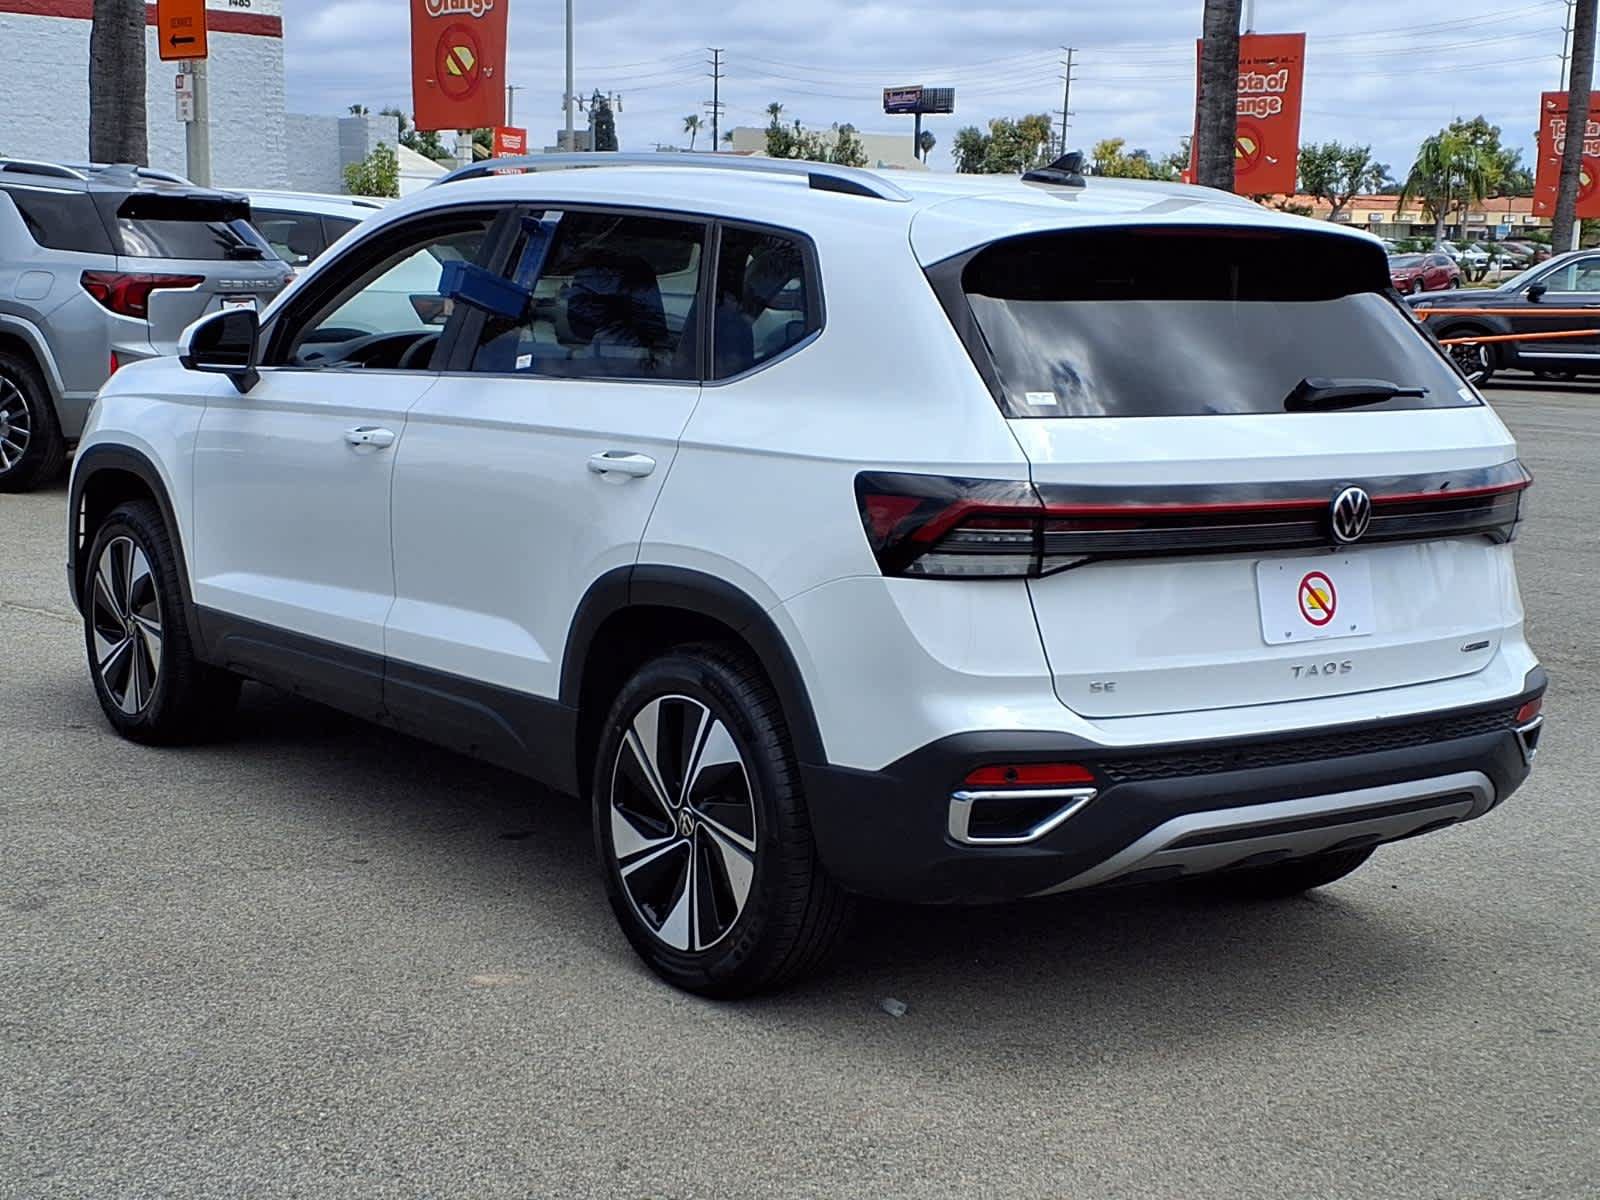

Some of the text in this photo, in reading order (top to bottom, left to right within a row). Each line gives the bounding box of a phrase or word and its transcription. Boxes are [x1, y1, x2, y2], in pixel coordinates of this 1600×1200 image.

[1267, 69, 1289, 92] of
[1236, 96, 1283, 118] ange
[1550, 119, 1600, 139] Tota
[1291, 660, 1353, 678] TAOS
[1089, 681, 1118, 693] SE
